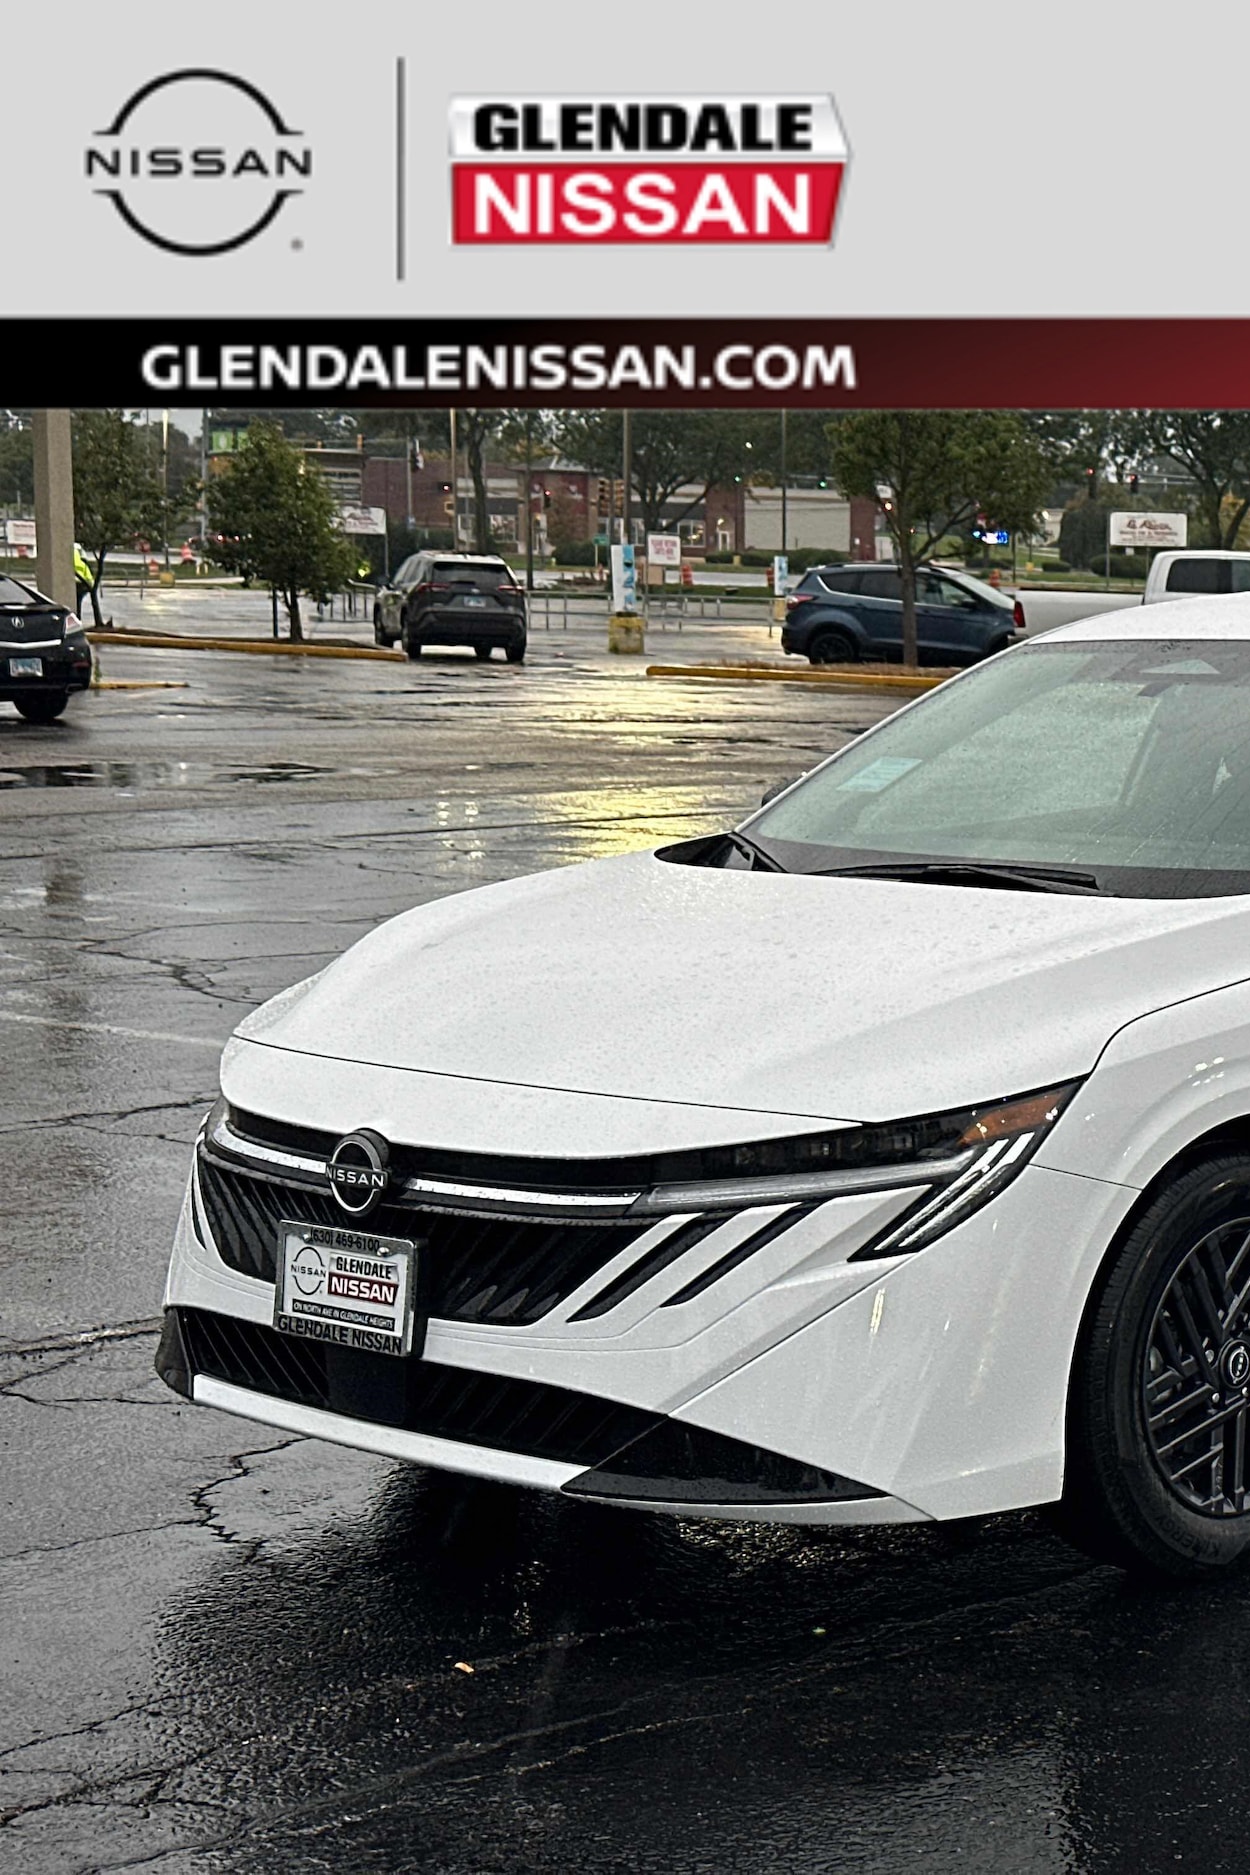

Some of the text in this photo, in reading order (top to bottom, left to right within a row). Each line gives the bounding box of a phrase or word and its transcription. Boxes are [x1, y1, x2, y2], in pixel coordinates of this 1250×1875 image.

[326, 1166, 384, 1187] NISSAN
[310, 1228, 380, 1251] (630) 469-6100
[291, 1264, 326, 1277] NISSAN
[336, 1257, 392, 1280] GLENDALE
[331, 1277, 394, 1303] NISSAN
[294, 1303, 302, 1311] ON
[303, 1305, 322, 1314] NORTH
[340, 1310, 369, 1323] GLENDALE
[369, 1316, 393, 1328] HEIGHTS
[278, 1316, 401, 1354] GLENDALE NISSAN
